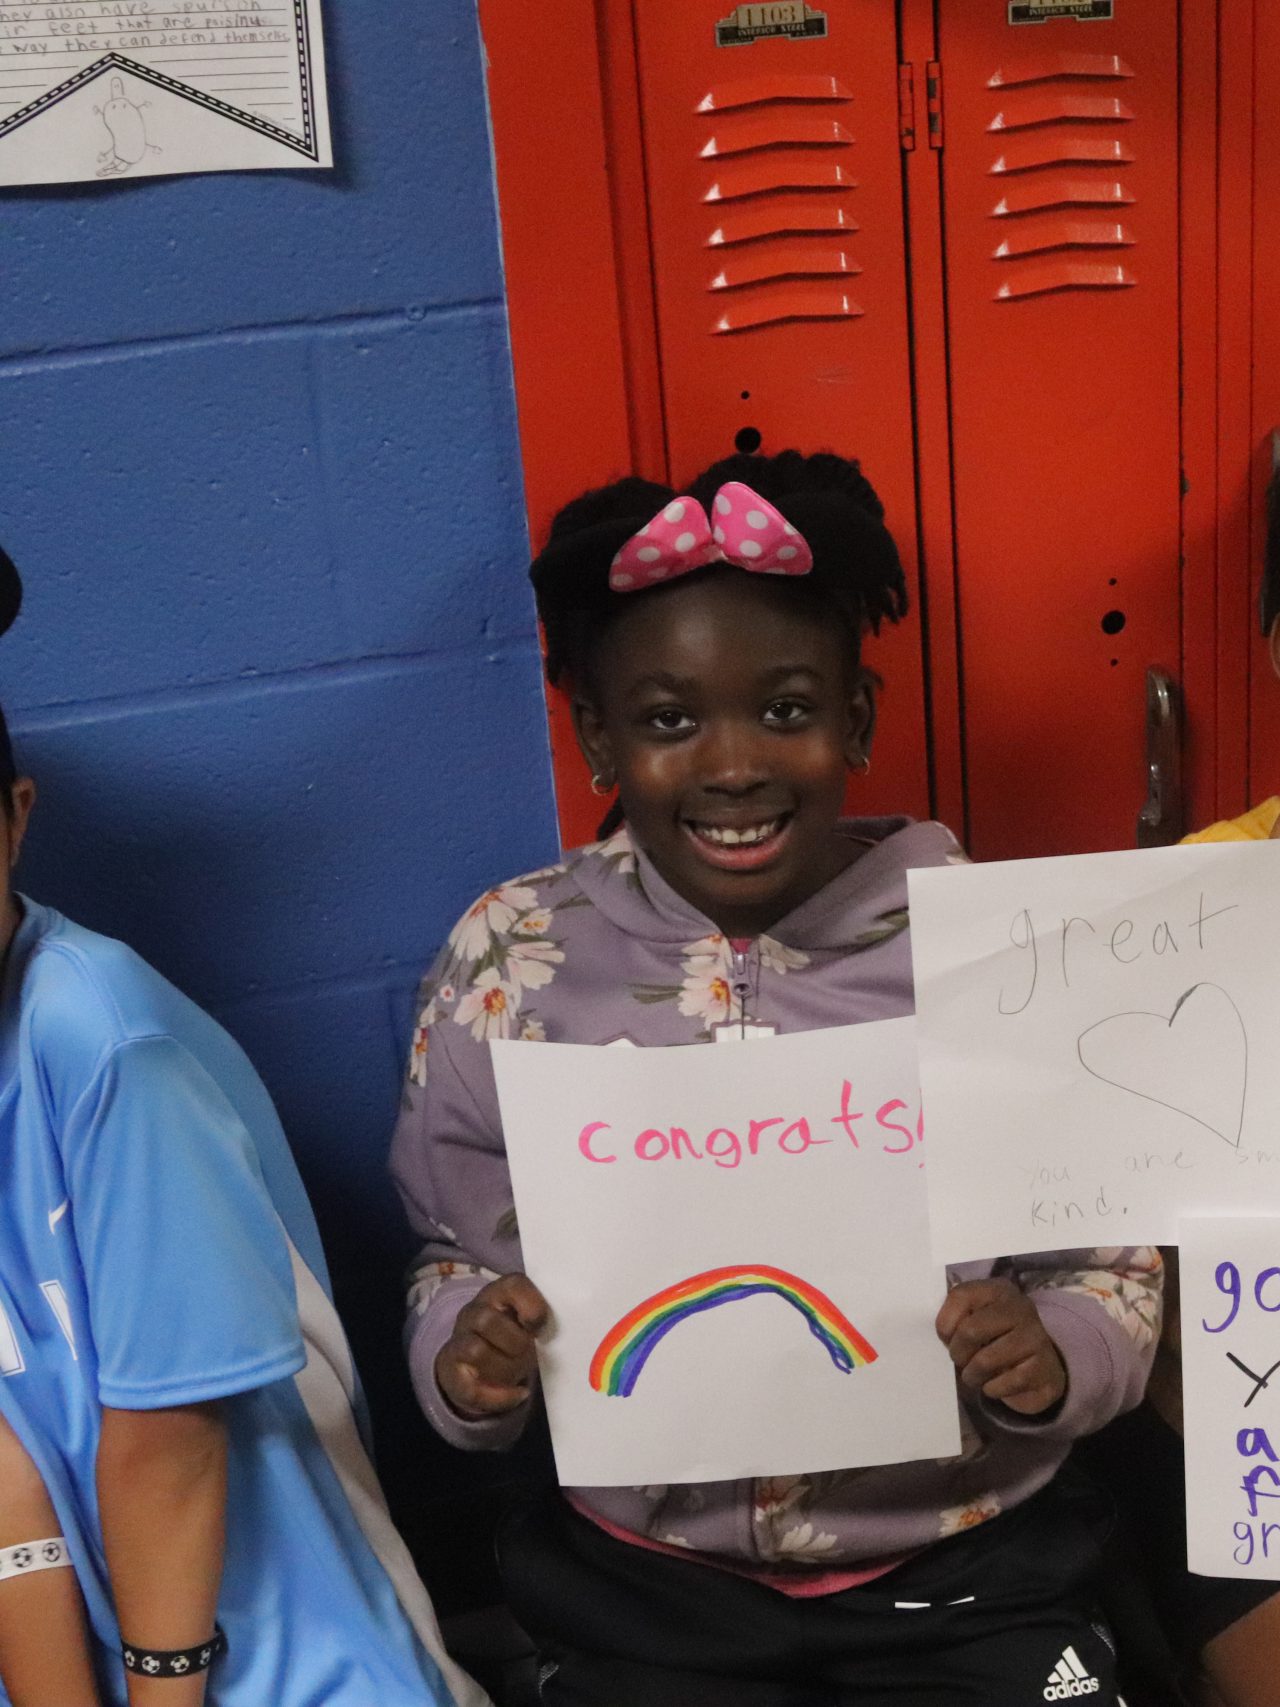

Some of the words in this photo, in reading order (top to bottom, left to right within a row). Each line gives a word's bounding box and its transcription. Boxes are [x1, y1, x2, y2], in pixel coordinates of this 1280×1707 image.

[746, 5, 796, 26] 1103
[999, 892, 1239, 1015] great
[1043, 1677, 1100, 1701] adidas
